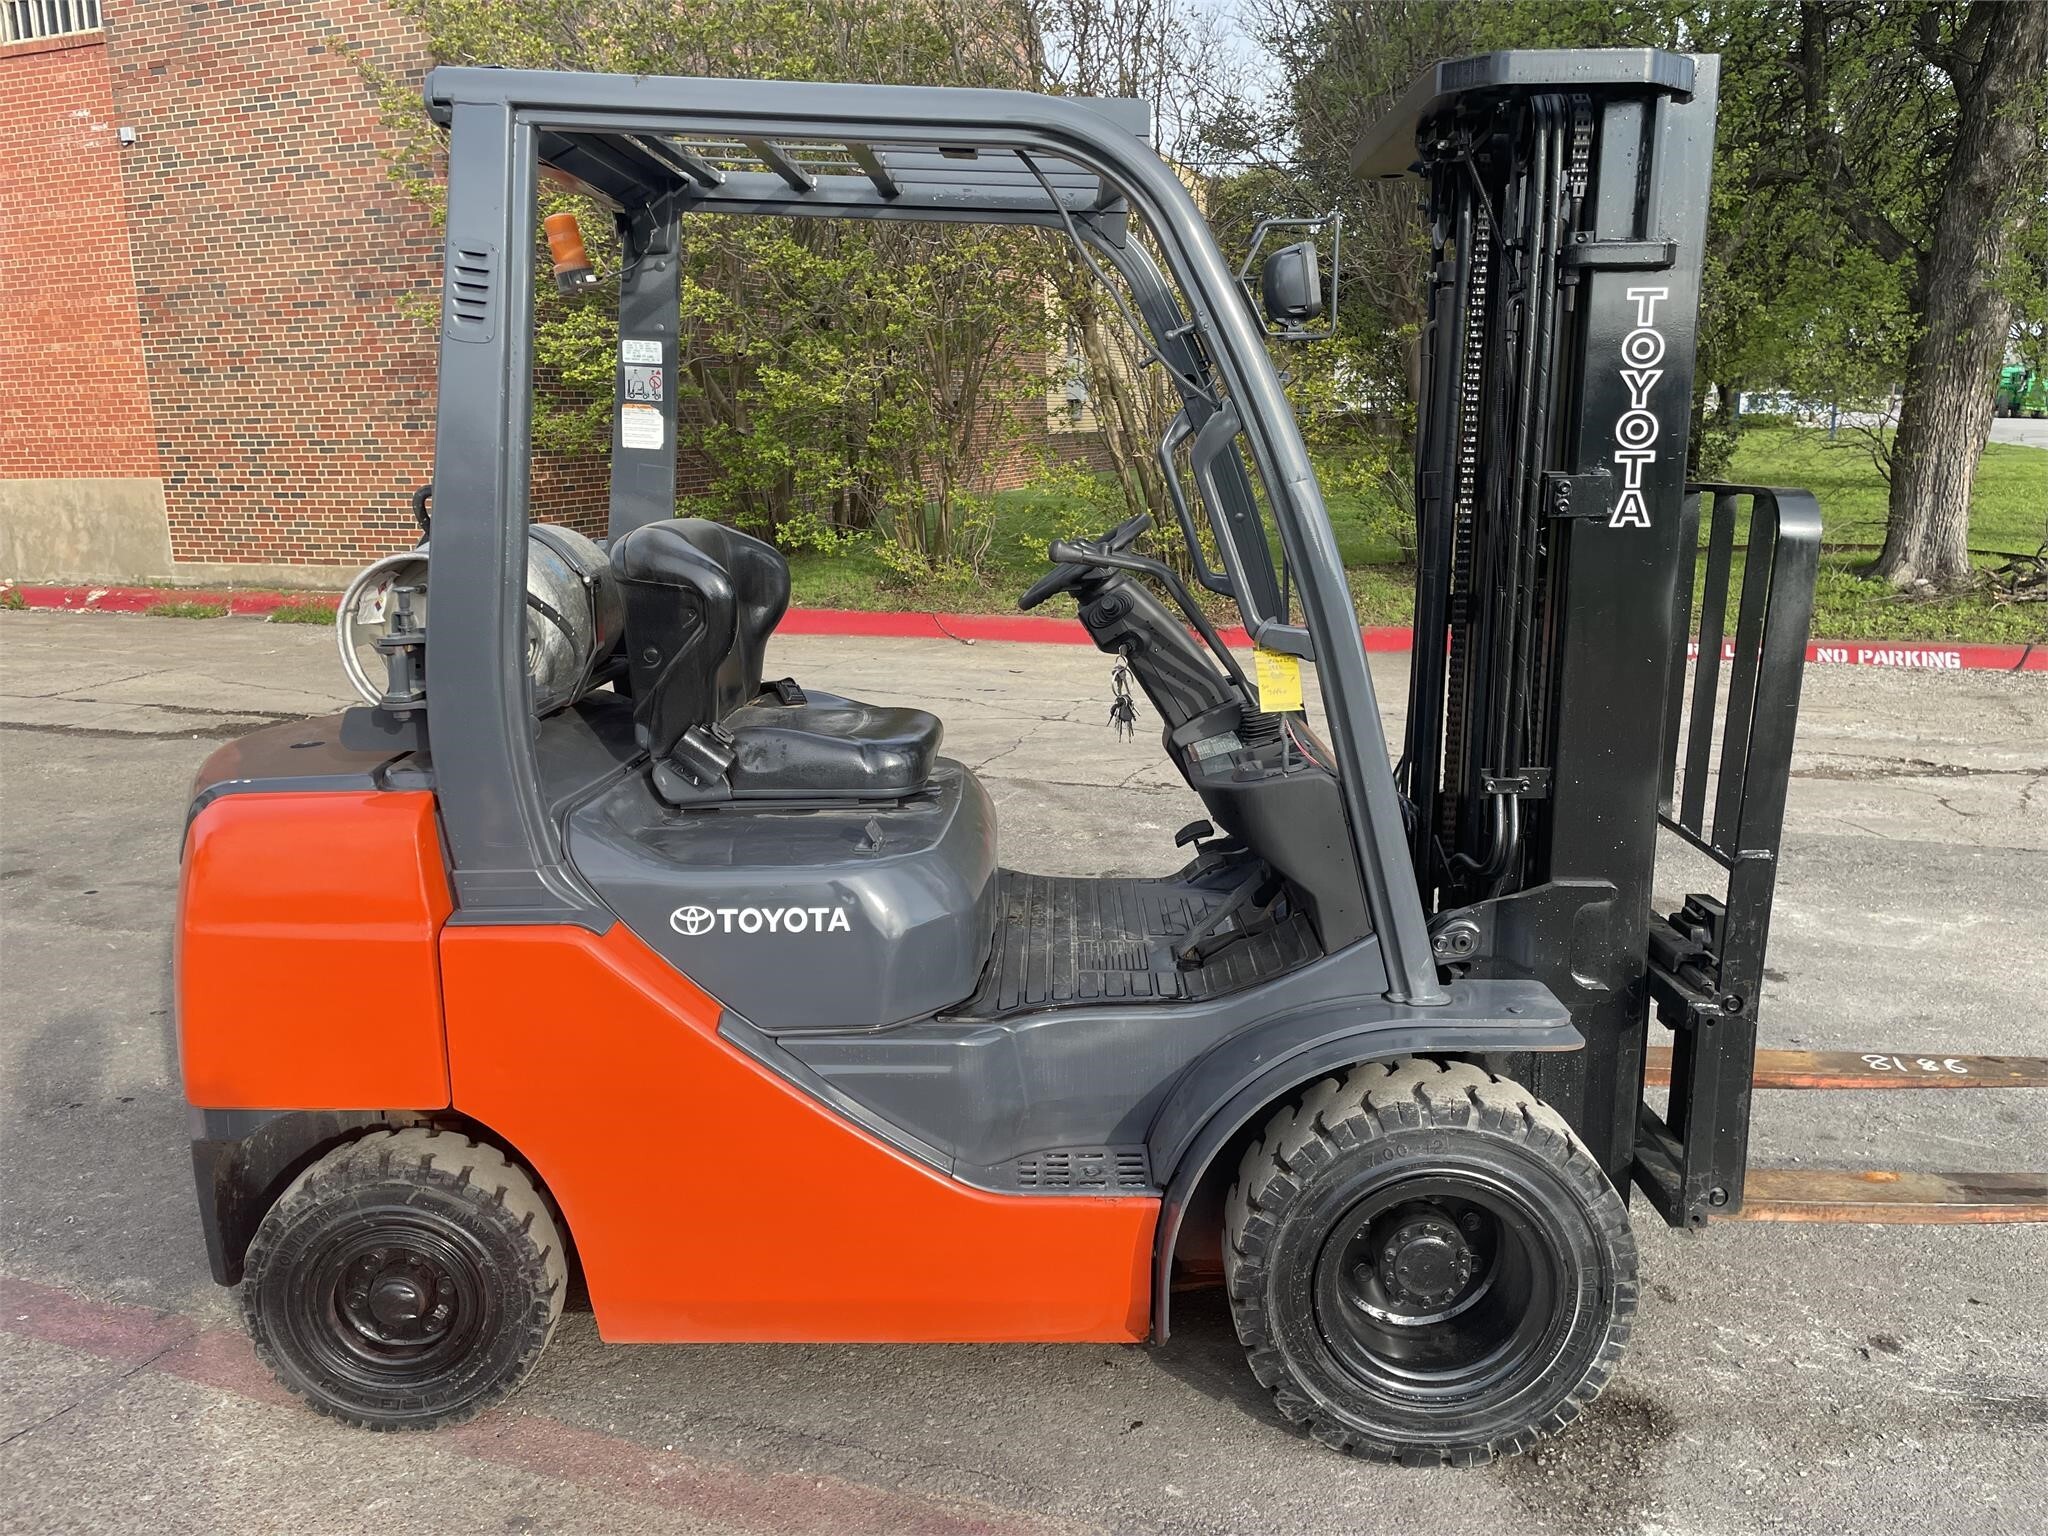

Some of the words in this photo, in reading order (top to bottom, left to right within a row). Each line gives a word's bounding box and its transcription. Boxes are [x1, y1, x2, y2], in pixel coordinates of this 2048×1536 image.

[1608, 287, 1669, 528] TOYOTA
[1816, 647, 1849, 663] NO
[1857, 649, 1962, 669] PARKING
[716, 906, 852, 934] TOYOTA
